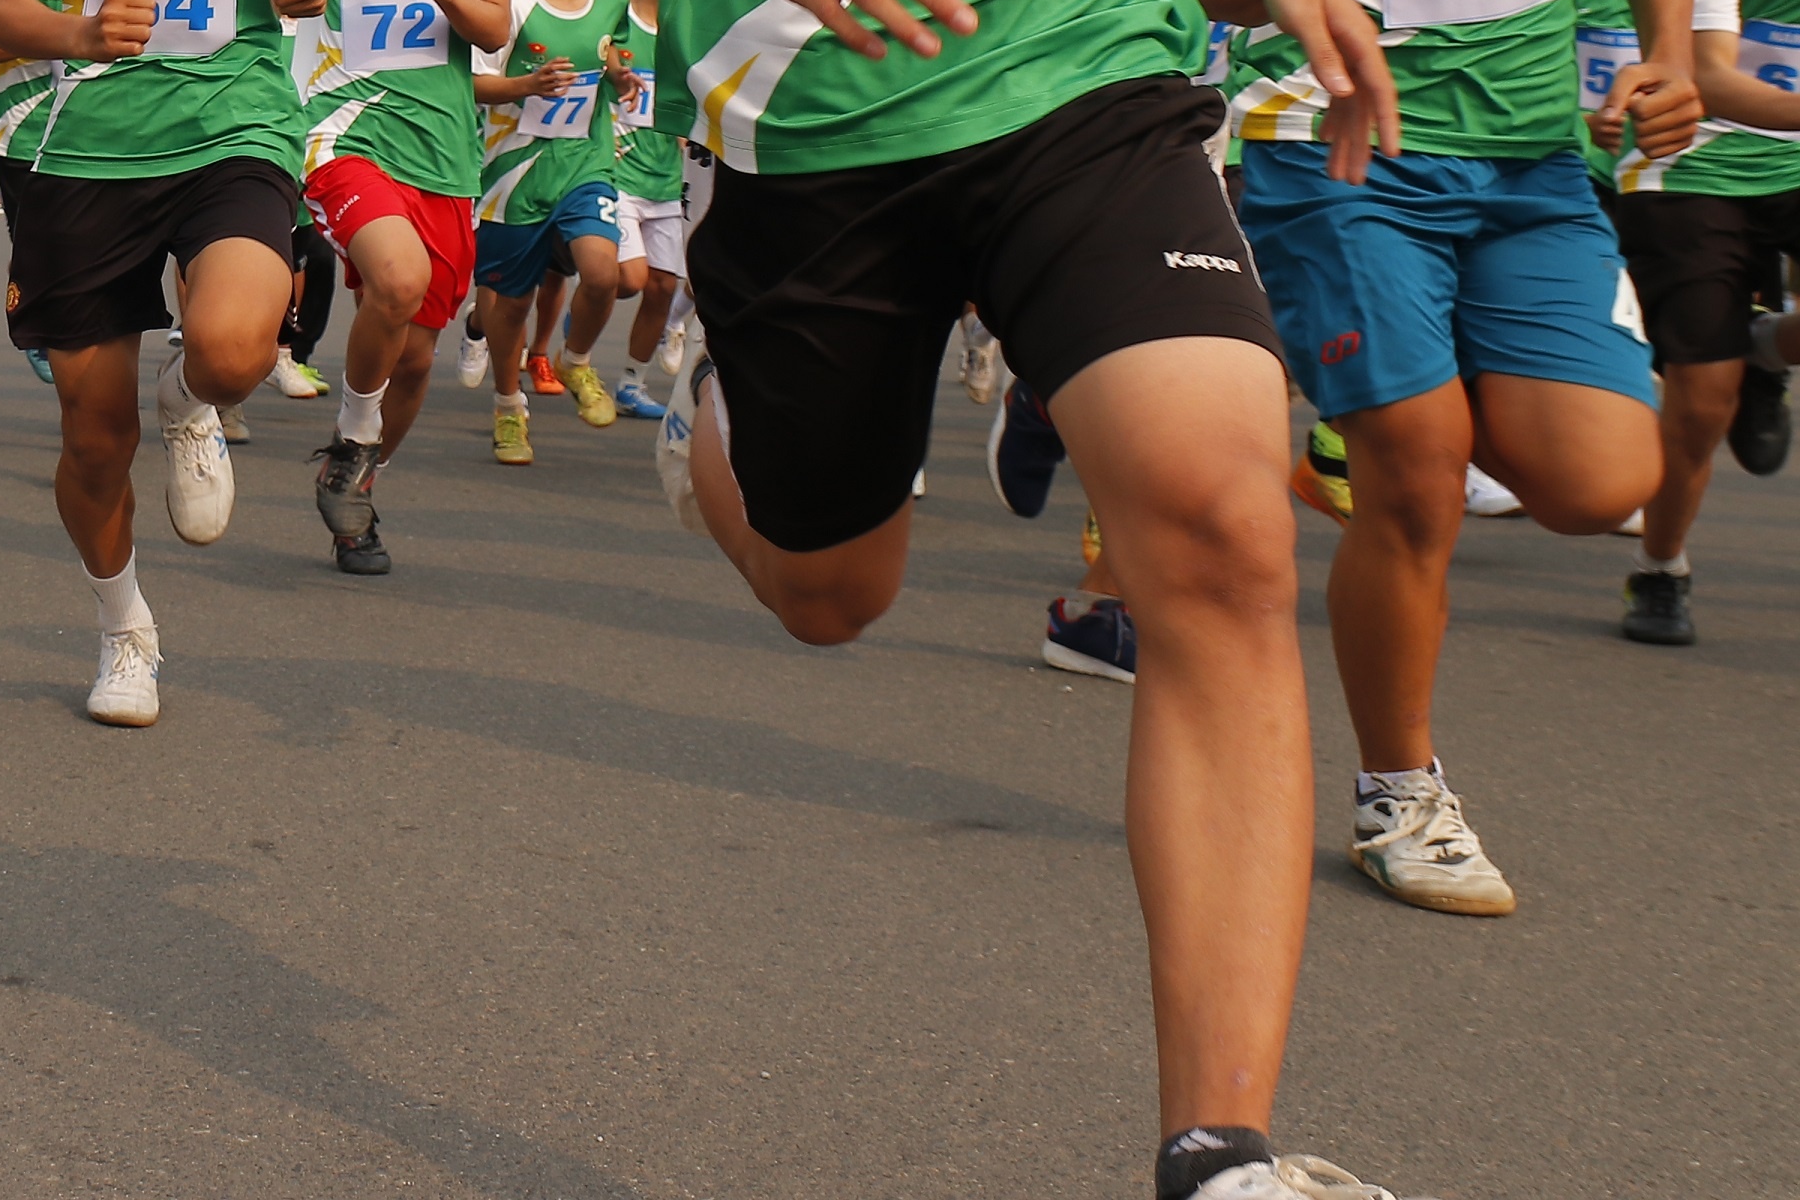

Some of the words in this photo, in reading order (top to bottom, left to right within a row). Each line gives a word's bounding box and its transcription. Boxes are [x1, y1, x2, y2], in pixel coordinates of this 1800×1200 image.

[362, 2, 435, 50] 72
[1585, 57, 1641, 95] 5
[541, 96, 589, 126] 77
[1163, 251, 1242, 274] Kappa
